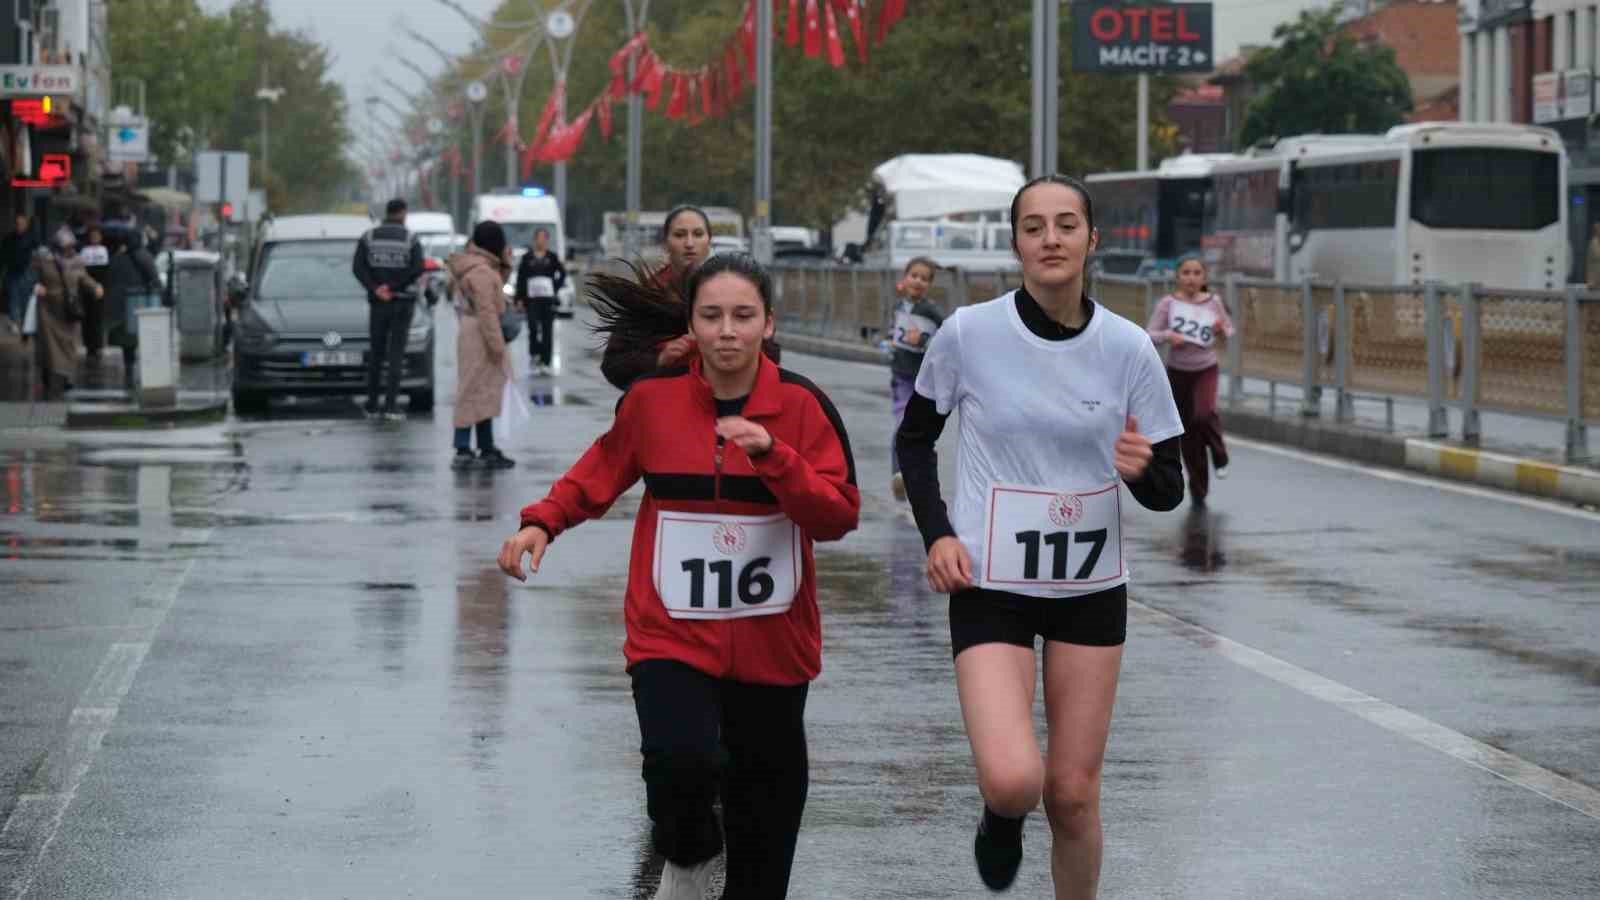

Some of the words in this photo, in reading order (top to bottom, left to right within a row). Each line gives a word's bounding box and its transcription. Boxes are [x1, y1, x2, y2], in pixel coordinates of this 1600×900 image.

[1090, 7, 1200, 41] OTEL
[1173, 317, 1211, 342] 226
[1015, 528, 1108, 580] 117
[680, 556, 775, 609] 116
